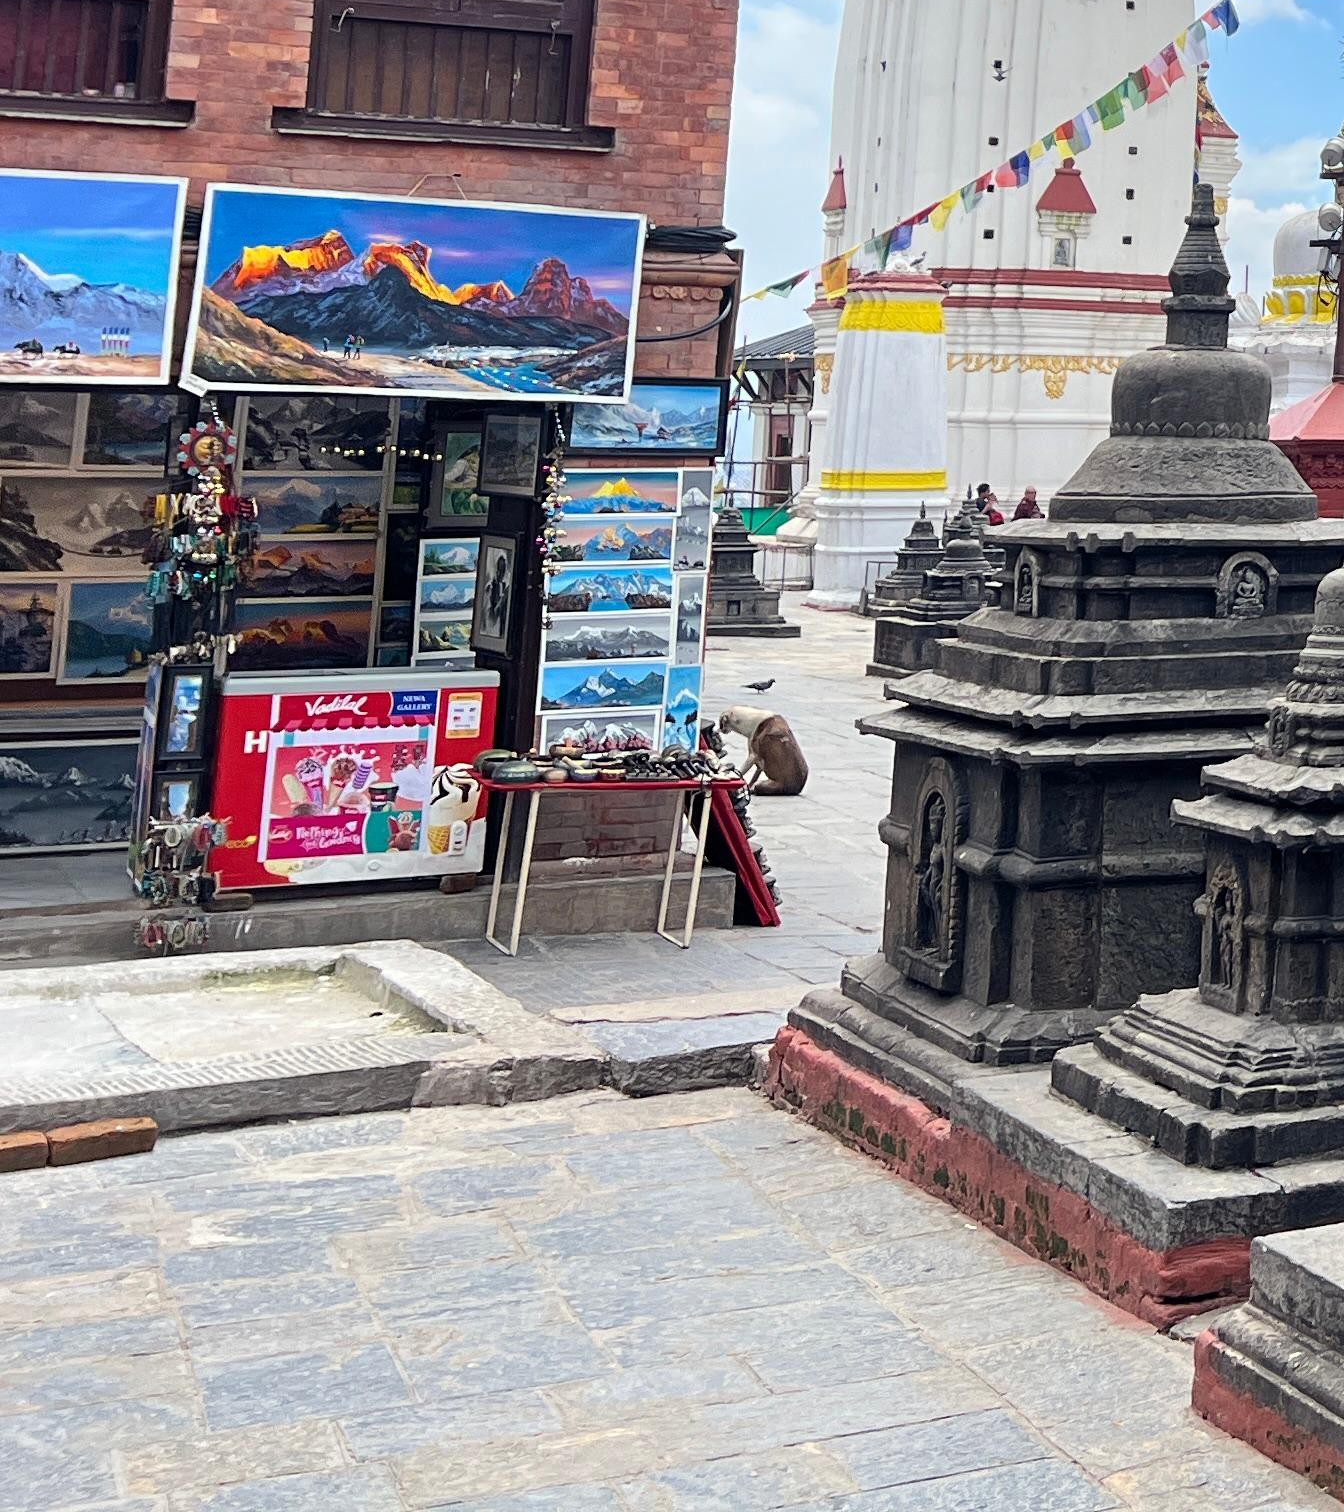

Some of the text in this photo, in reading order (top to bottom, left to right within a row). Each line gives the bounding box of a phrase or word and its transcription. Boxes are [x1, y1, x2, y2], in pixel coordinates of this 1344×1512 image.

[402, 695, 426, 703] NEWA
[305, 695, 368, 716] Vadilal
[396, 703, 433, 711] GALLERY
